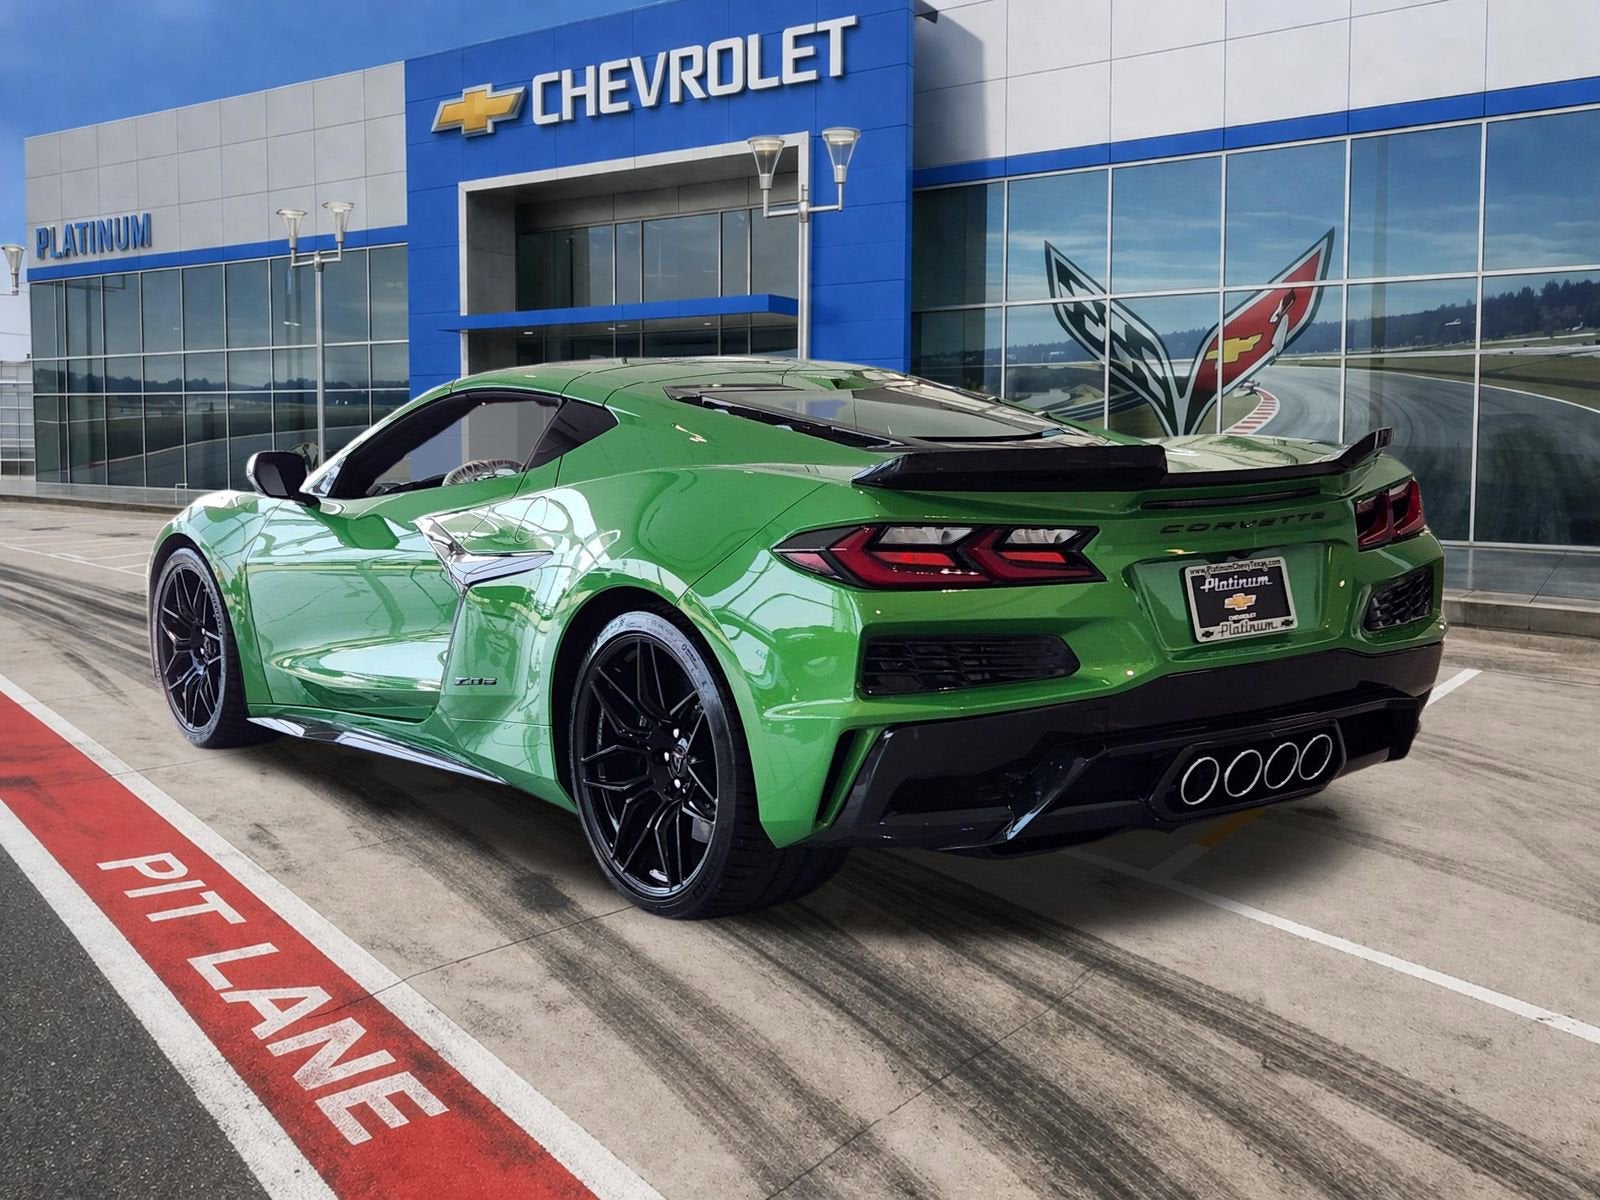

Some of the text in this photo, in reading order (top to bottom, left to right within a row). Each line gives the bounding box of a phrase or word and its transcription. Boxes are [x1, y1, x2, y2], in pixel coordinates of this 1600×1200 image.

[532, 15, 858, 125] CHEVROLET
[36, 212, 152, 260] PLATINUM
[1160, 510, 1327, 534] CORVETTE
[1200, 575, 1273, 593] Platinum
[1218, 620, 1278, 637] Platinum
[96, 852, 450, 1146] PIT LANE
